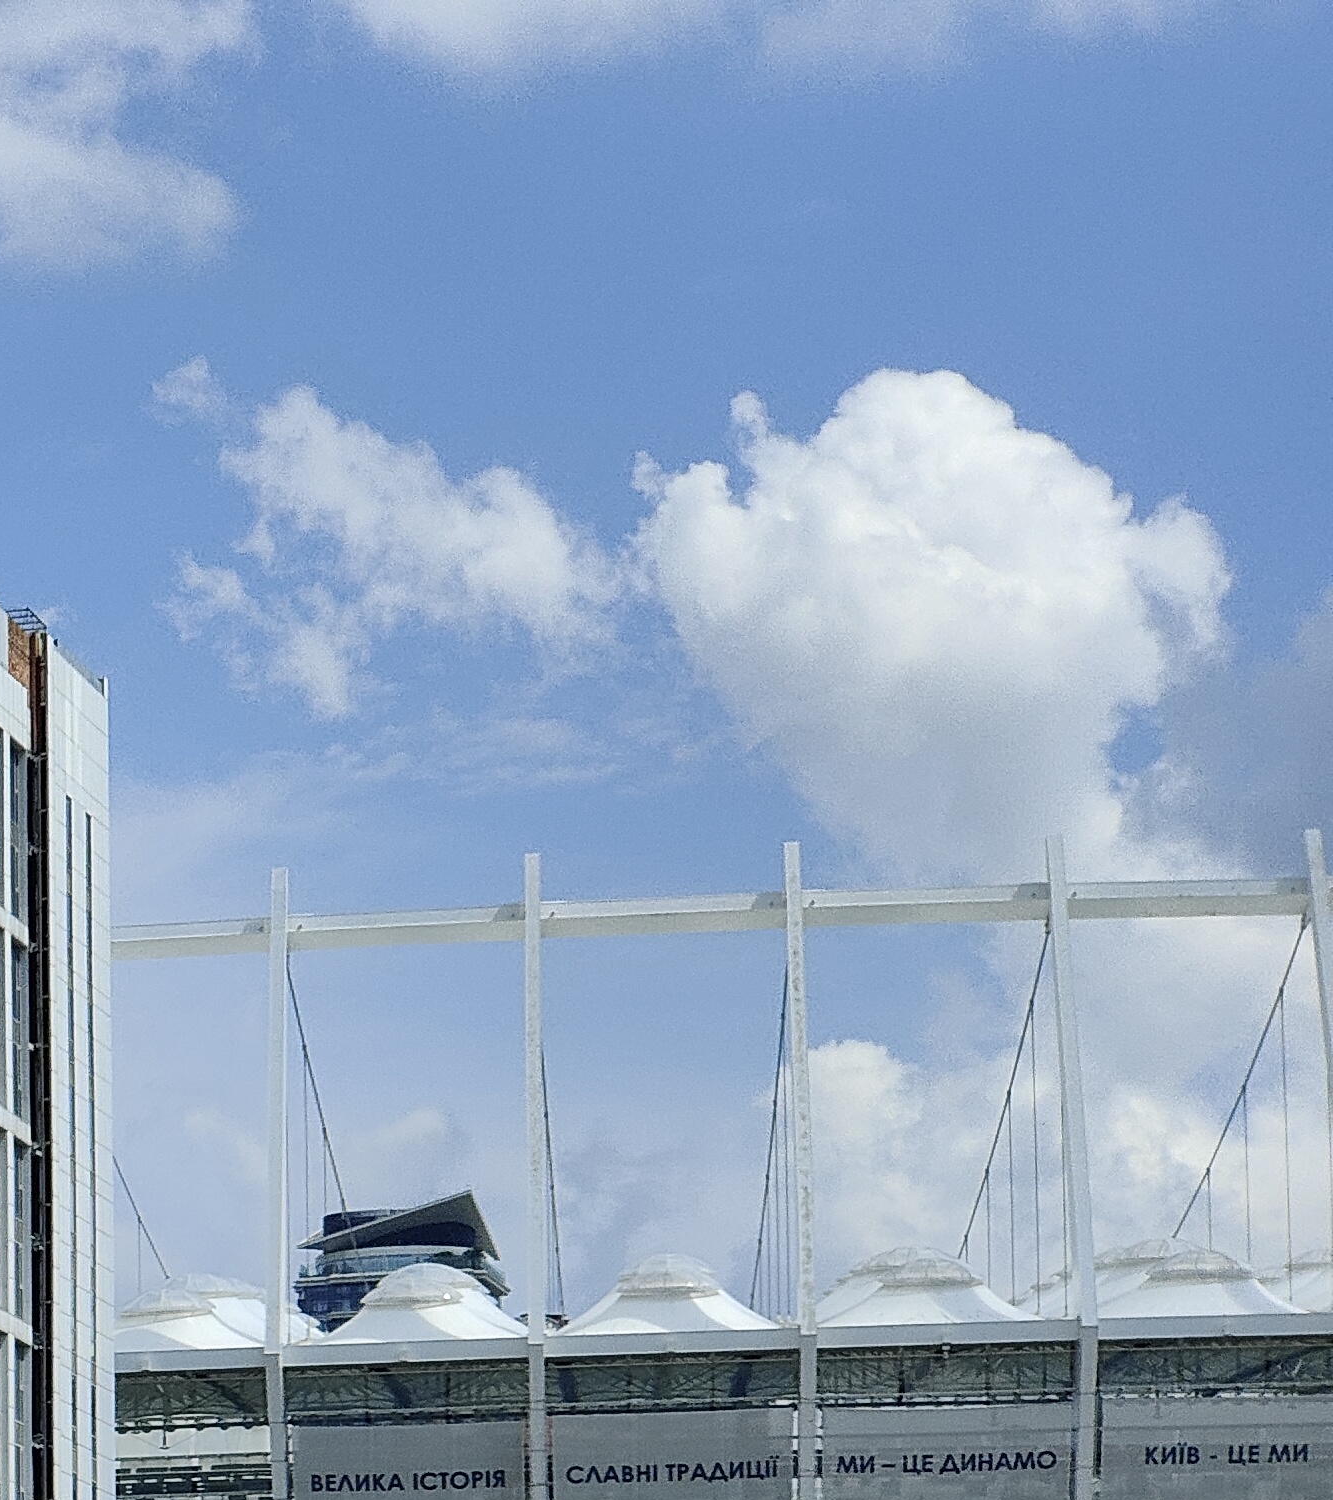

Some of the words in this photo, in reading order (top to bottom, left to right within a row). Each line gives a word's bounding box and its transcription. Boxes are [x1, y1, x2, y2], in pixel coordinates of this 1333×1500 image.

[835, 1454, 876, 1474] МИ
[902, 1454, 934, 1475] ЦЕ
[938, 1450, 1058, 1475] ДИНАМО
[1145, 1442, 1200, 1465] КИЇВ
[1227, 1445, 1260, 1466] ЦЕ
[1267, 1443, 1310, 1464] МИ
[310, 1473, 405, 1493] ВЕЛИКА
[412, 1469, 507, 1491] ІСТОРІЯ
[565, 1464, 659, 1484] СЛАВНІ
[664, 1454, 781, 1482] ТРАДИЦІЇ
